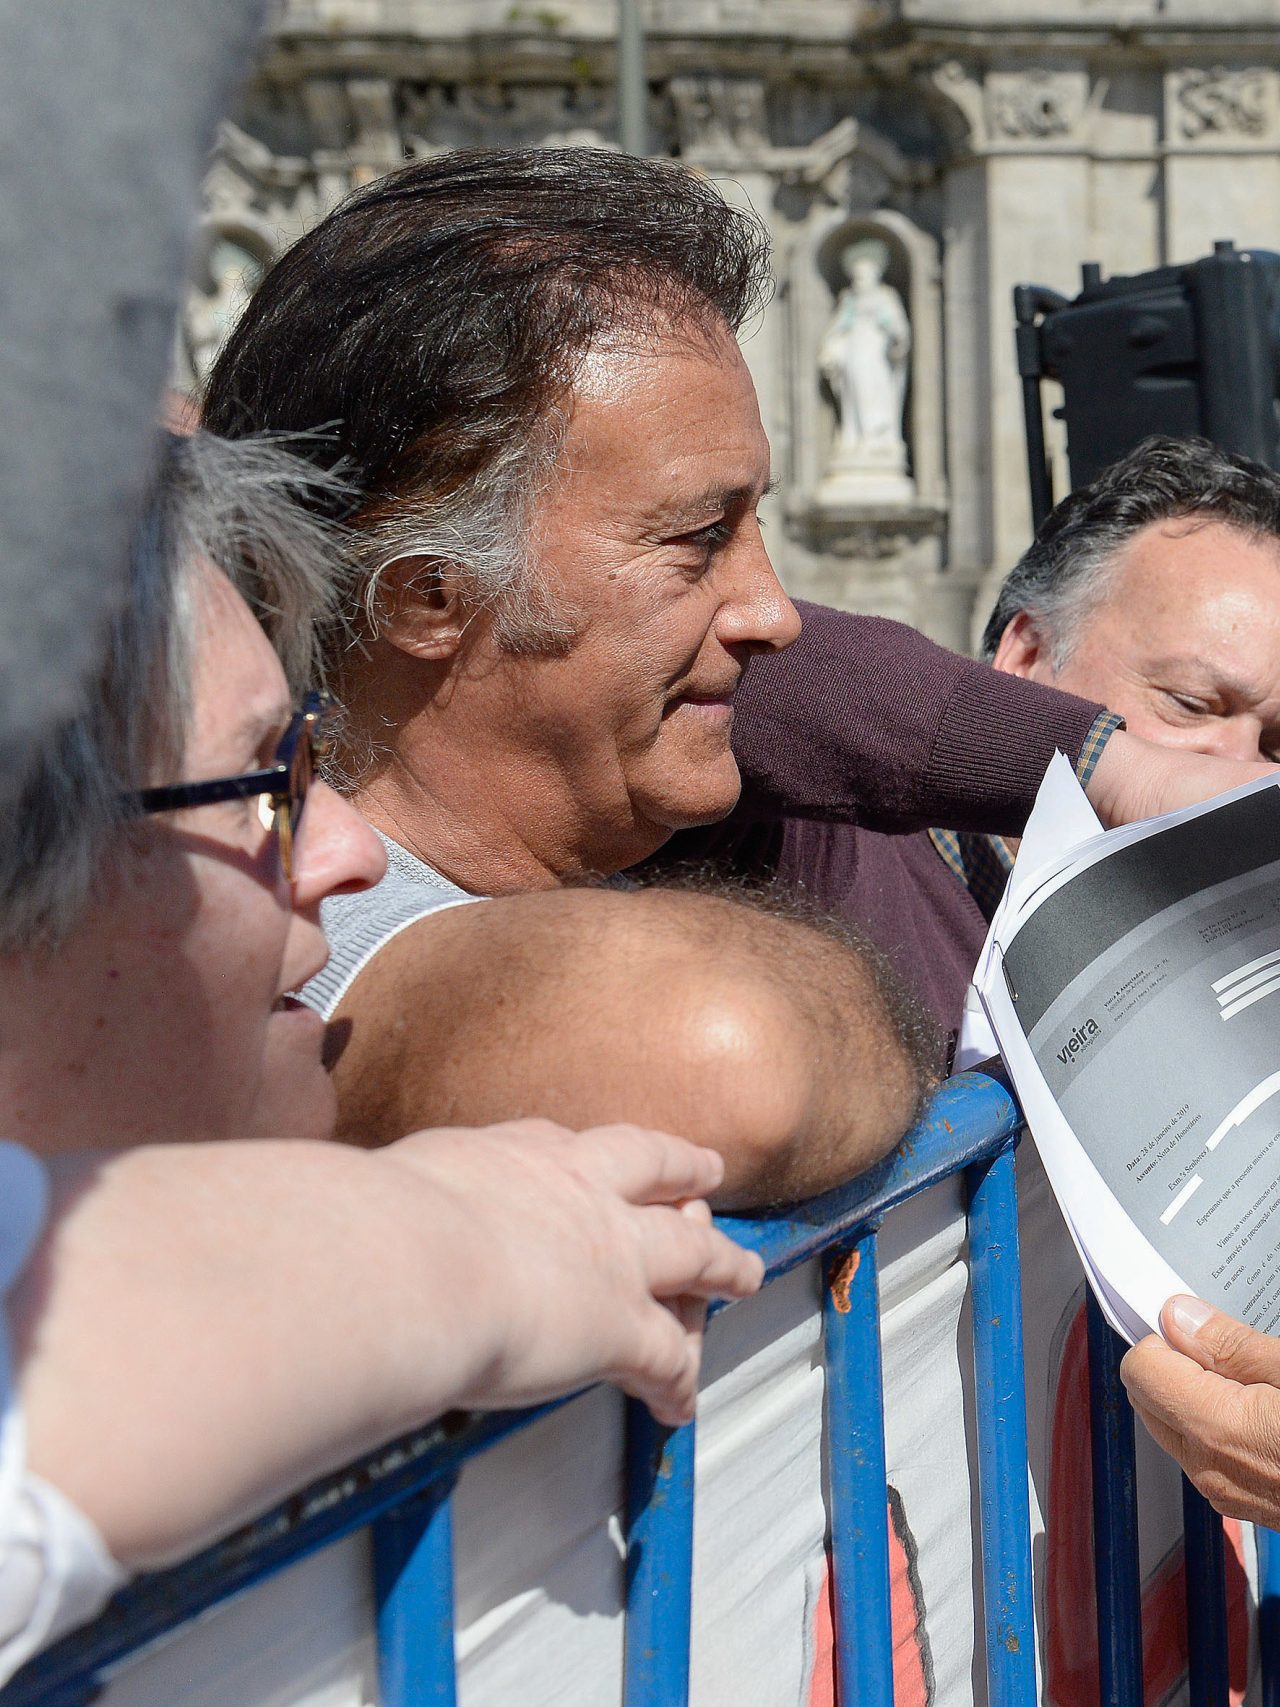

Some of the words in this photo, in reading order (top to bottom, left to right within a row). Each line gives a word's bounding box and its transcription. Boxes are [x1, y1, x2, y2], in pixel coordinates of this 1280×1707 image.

[1056, 1018, 1099, 1065] vieira
[1126, 1155, 1142, 1171] Data:
[1153, 1124, 1171, 1145] janeiro
[1176, 1103, 1189, 1119] 2019
[1136, 1159, 1158, 1184] Assunto:
[1156, 1147, 1170, 1161] Nota
[1174, 1114, 1201, 1142] Honorários
[1184, 1150, 1207, 1173] Senhores
[1196, 1198, 1223, 1226] Esperamos
[1234, 1164, 1253, 1187] presente
[1252, 1146, 1269, 1166] missiva
[1216, 1231, 1234, 1248] Vimos
[1239, 1209, 1253, 1224] vosso
[1225, 1244, 1242, 1264] através
[1247, 1211, 1270, 1240] procuração
[1230, 1265, 1247, 1282] anexo.
[1246, 1268, 1261, 1285] Como
[1242, 1286, 1266, 1316] contratados
